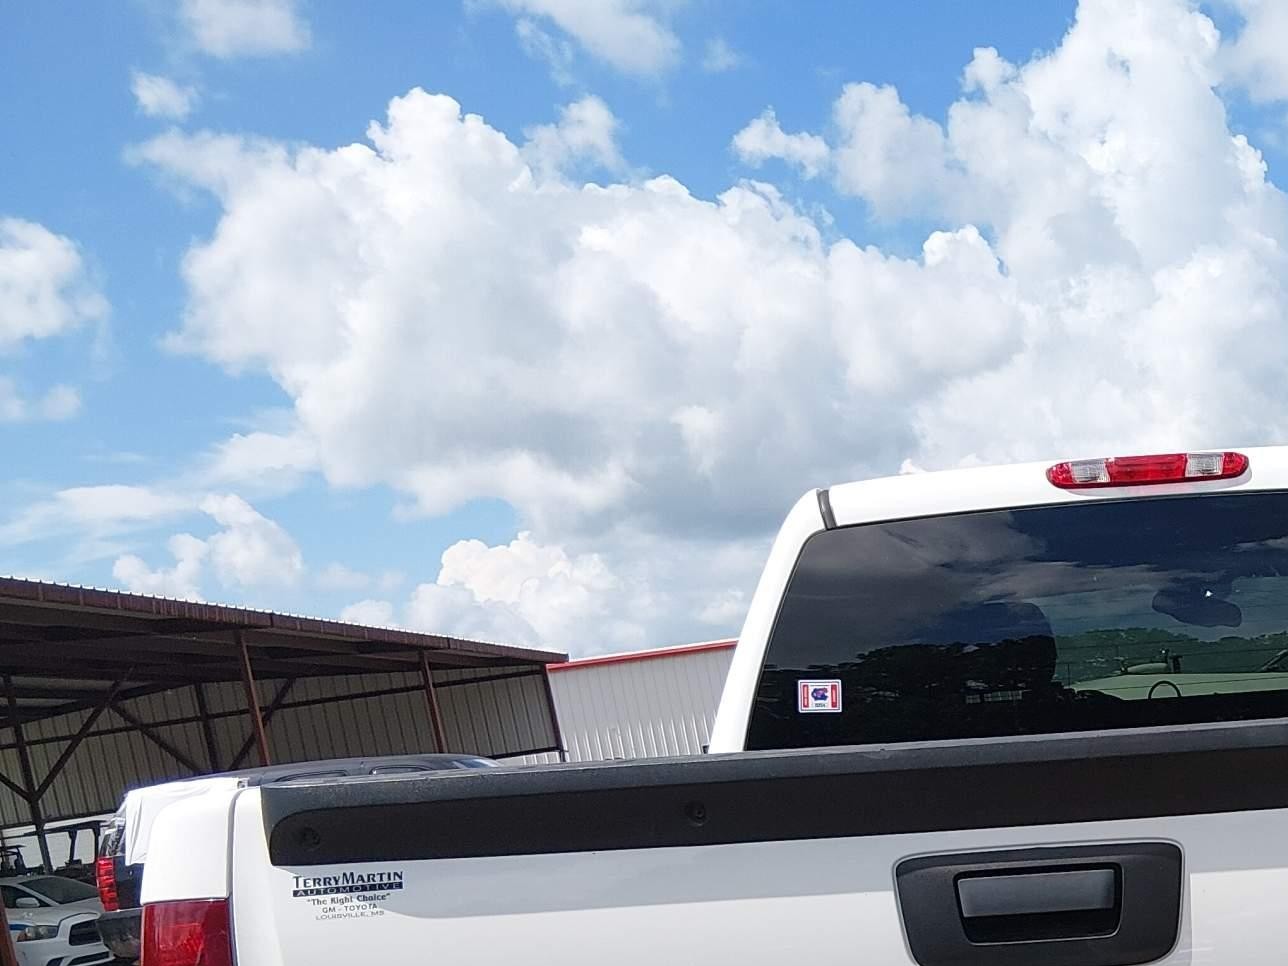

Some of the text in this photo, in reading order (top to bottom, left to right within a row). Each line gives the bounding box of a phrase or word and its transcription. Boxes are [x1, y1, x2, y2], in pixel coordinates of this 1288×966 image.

[296, 882, 401, 897] AUTOMOTIVE
[330, 896, 353, 906] Right
[322, 906, 336, 914] GM
[344, 903, 378, 911] TOYOTA
